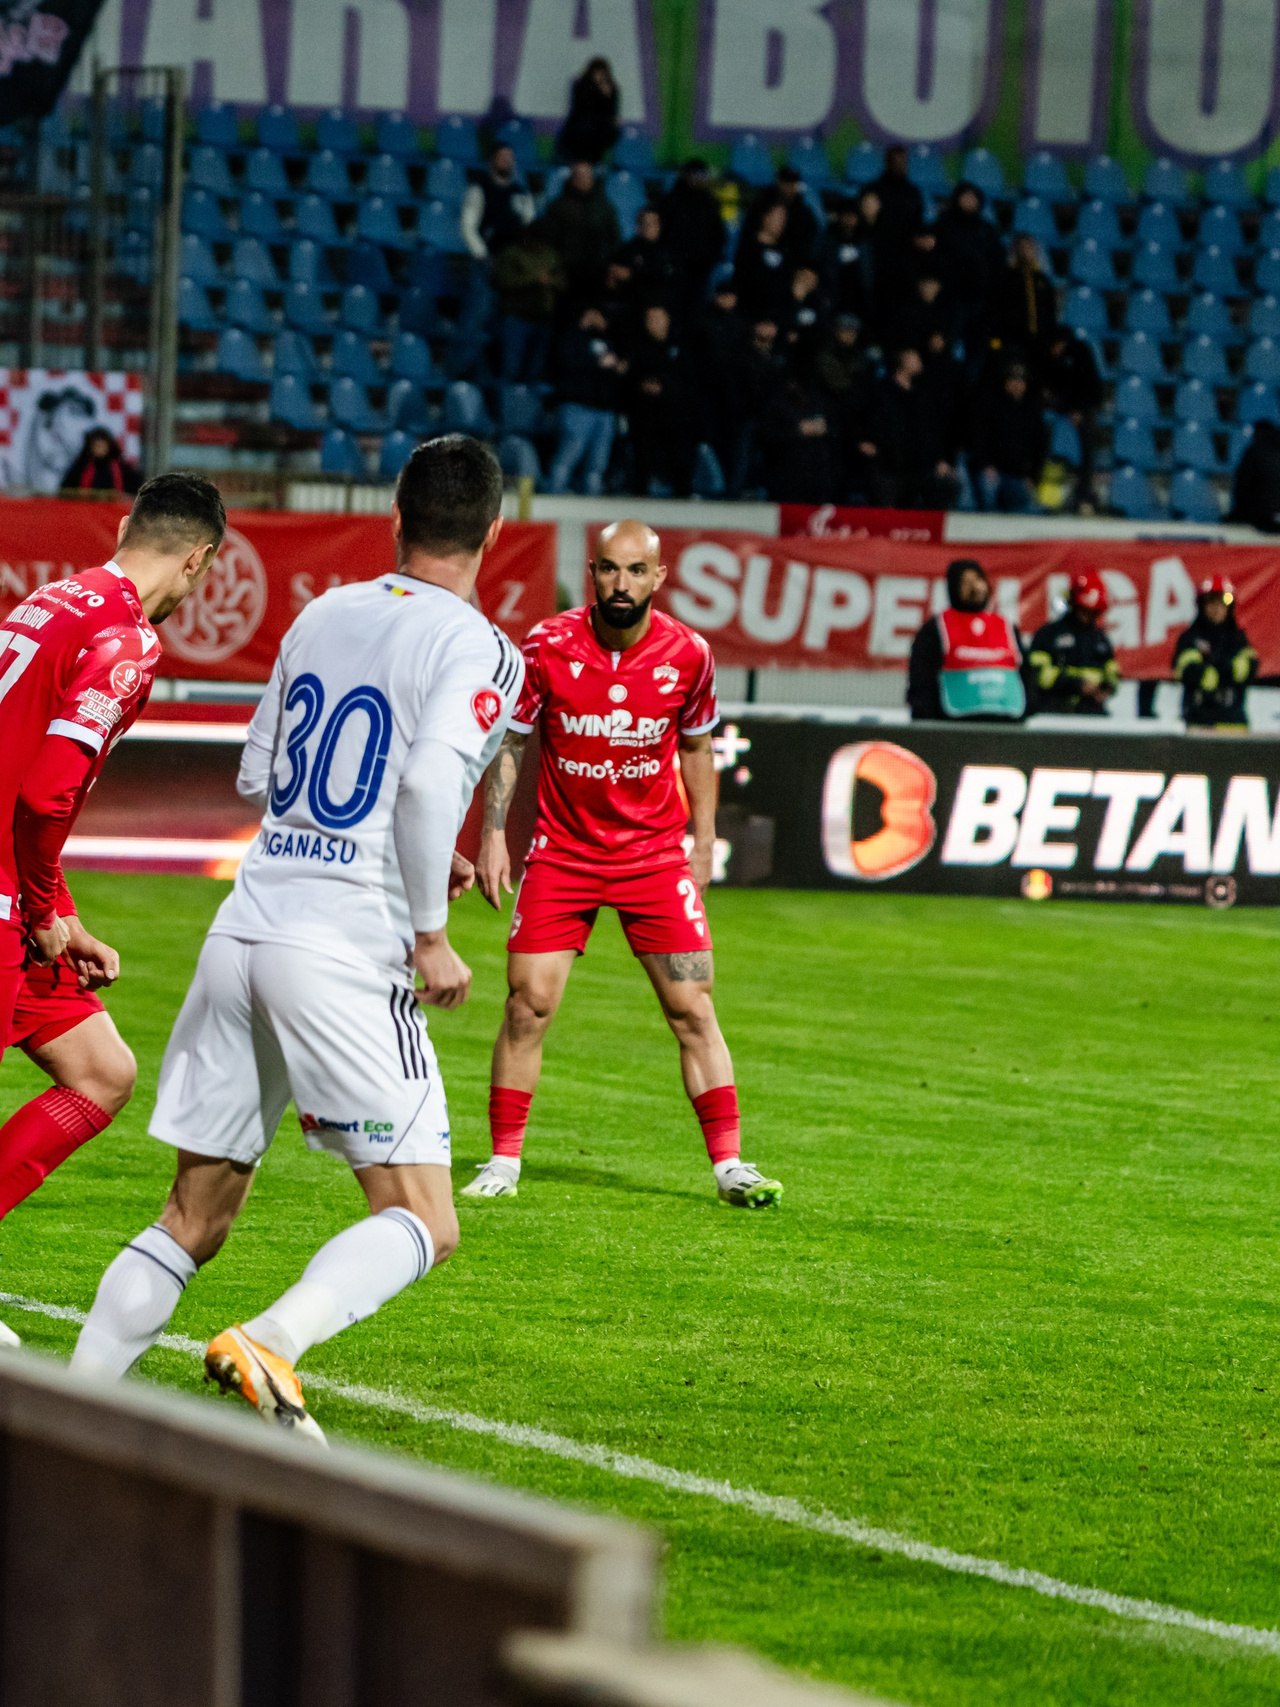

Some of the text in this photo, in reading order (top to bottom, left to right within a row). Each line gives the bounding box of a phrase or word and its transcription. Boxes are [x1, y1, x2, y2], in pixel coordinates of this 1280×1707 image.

[87, 688, 111, 707] DOAR
[559, 708, 670, 739] WIN2.RO
[270, 672, 393, 829] 30
[609, 738, 639, 748] CASINO
[676, 878, 703, 921] 2
[318, 1116, 394, 1133] Smart Eco
[368, 1131, 394, 1144] Plus
